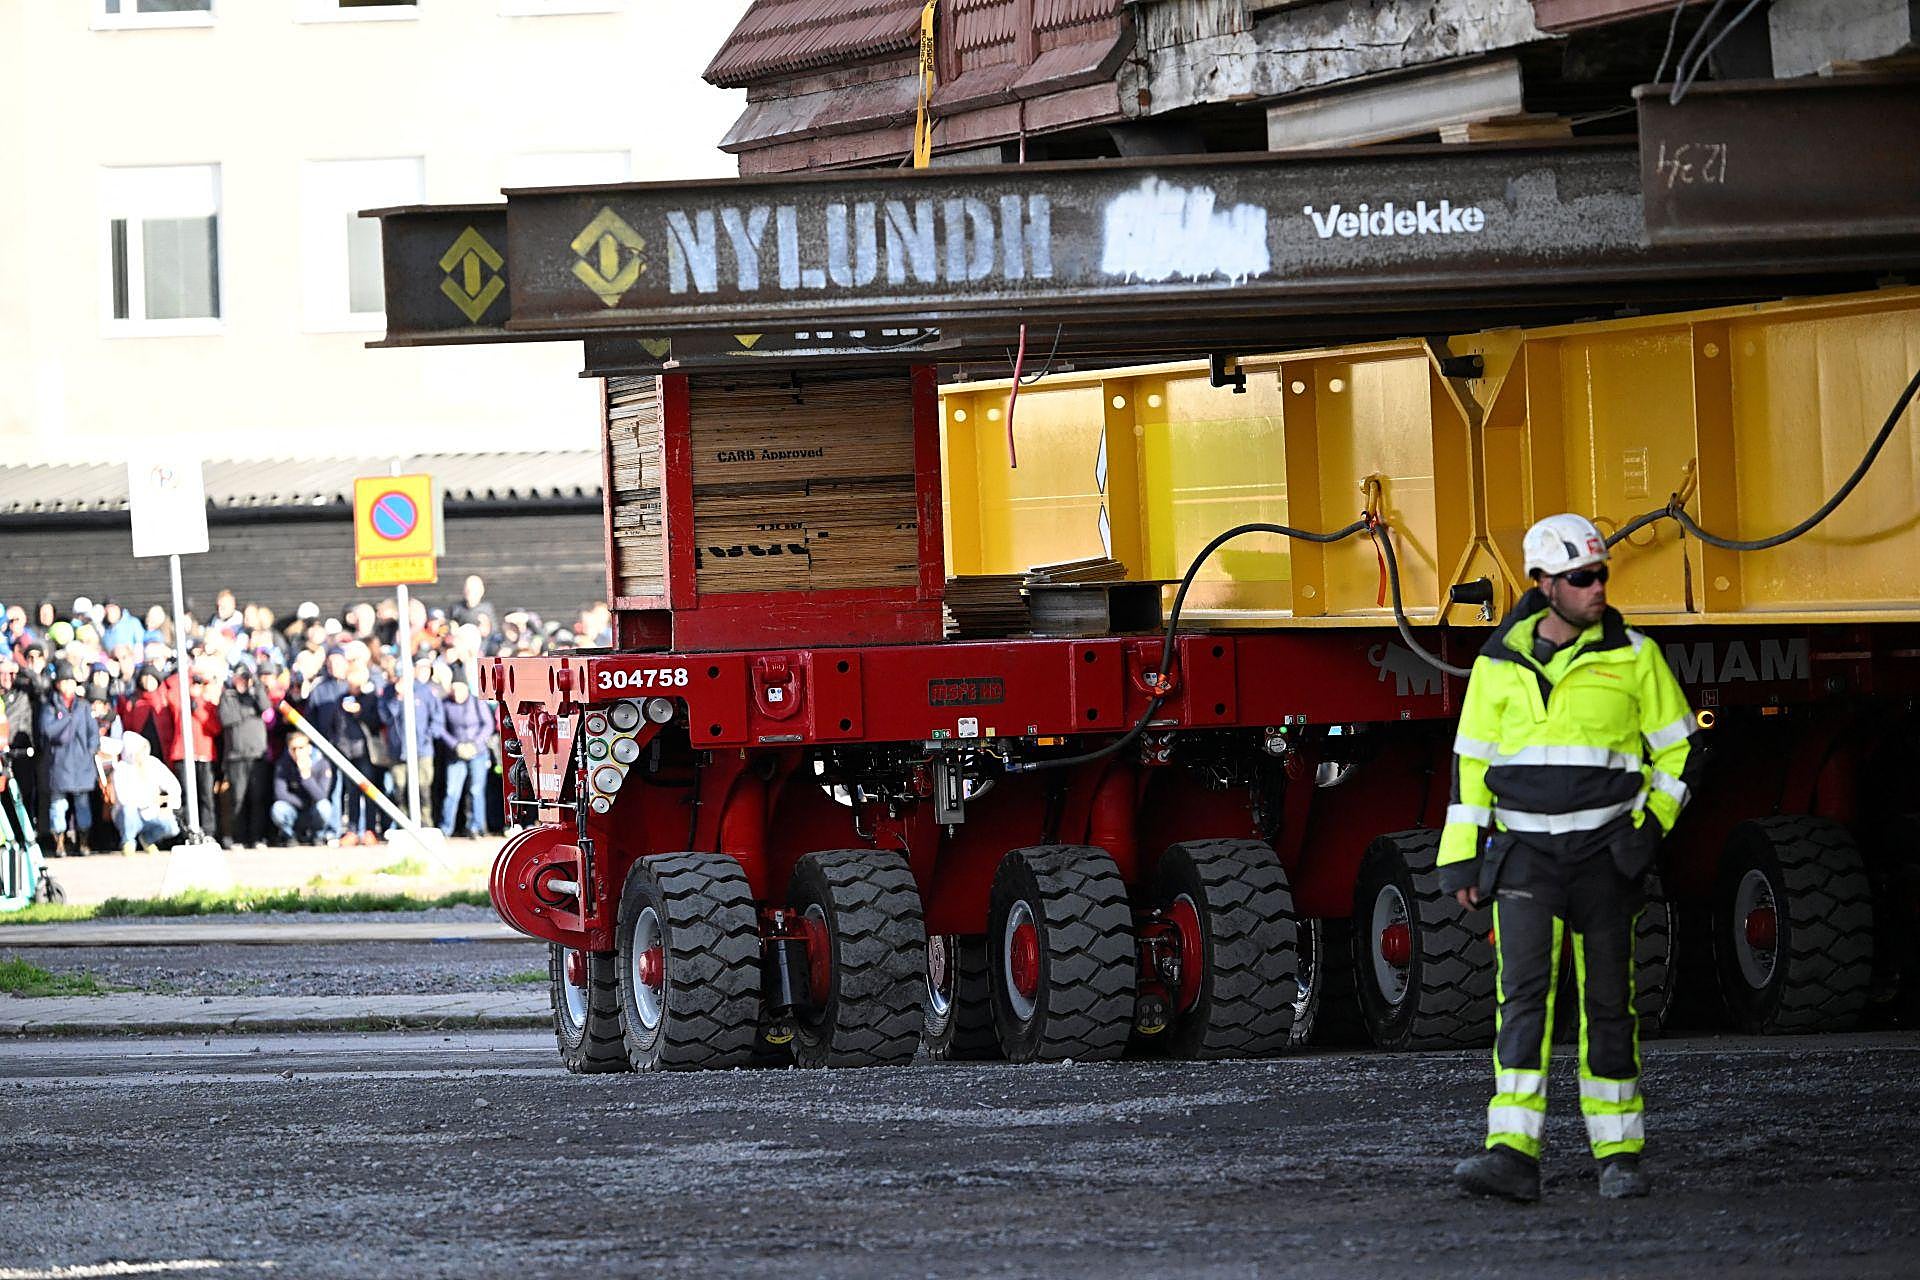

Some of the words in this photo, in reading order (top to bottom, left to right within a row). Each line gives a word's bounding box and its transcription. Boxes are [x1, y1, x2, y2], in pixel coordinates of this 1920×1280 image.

[1303, 200, 1486, 238] Veidekke
[667, 194, 1052, 294] NYLUNDH
[717, 449, 755, 462] CARB
[761, 447, 823, 461] Approved
[598, 668, 688, 689] 304758
